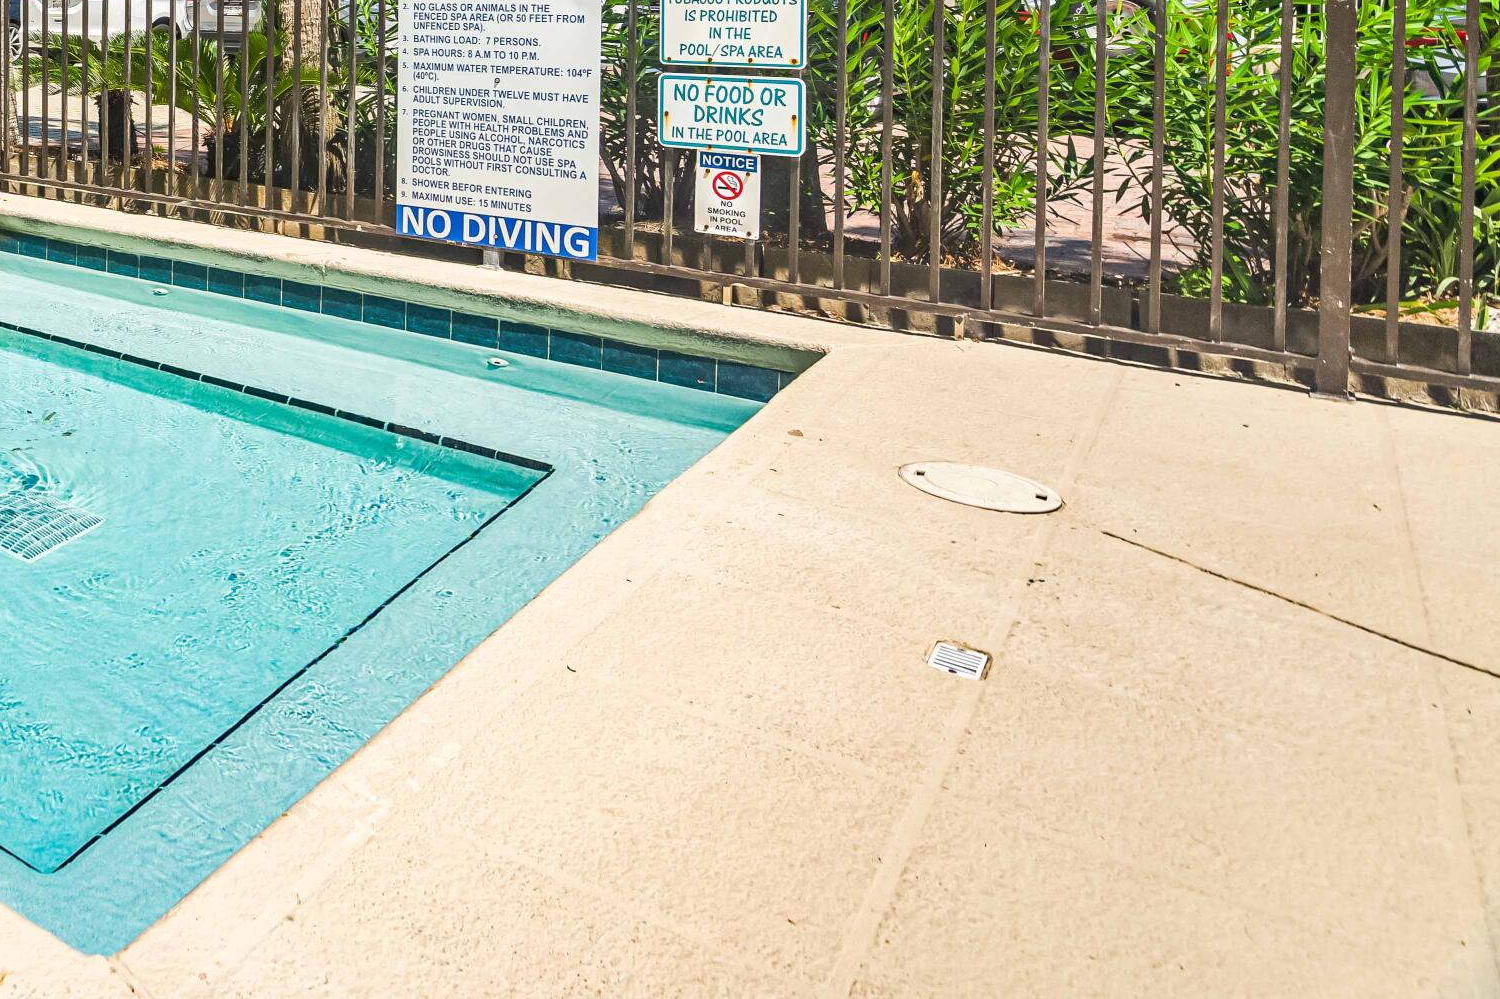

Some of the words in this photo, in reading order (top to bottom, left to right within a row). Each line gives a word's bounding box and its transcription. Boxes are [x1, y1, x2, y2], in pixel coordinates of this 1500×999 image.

[414, 3, 426, 11] NO
[428, 3, 457, 12] GLASS
[460, 3, 473, 12] OR
[475, 4, 516, 12] ANIMALS
[519, 4, 528, 12] IN
[531, 4, 550, 12] THE
[414, 12, 448, 20] FENCED
[450, 13, 467, 21] SPA
[469, 13, 494, 22] AREA
[497, 14, 513, 23] (OR
[516, 14, 526, 22] 50
[529, 14, 554, 22] FEET
[556, 15, 584, 23] FROM
[685, 9, 696, 21] IS
[700, 10, 777, 22] PROHIBITED
[414, 22, 460, 30] UNFENCED
[463, 23, 485, 32] SPA).
[709, 27, 721, 39] IN
[725, 27, 751, 40] THE
[414, 35, 450, 44] BATHING
[454, 36, 480, 44] LOAD:
[486, 37, 491, 45] 7
[494, 37, 540, 46] PERSONS.
[413, 48, 430, 56] SPA
[432, 49, 465, 58] HOURS:
[468, 50, 472, 58] 8
[493, 51, 506, 59] TO
[509, 51, 518, 60] 10
[522, 52, 539, 60] P.M.
[680, 43, 744, 57] POOL/SPA
[748, 45, 782, 58] AREA
[414, 62, 454, 71] MAXIMUM
[457, 64, 487, 73] WATER
[490, 65, 563, 76] TEMPERATURE:
[413, 71, 439, 82] (40°C).
[413, 85, 456, 95] CHILDREN
[459, 88, 490, 97] UNDER
[492, 90, 530, 100] TWELVE
[533, 92, 559, 101] MUST
[562, 94, 588, 103] HAVE
[674, 84, 699, 102] NO
[705, 85, 754, 104] FOOD
[760, 87, 786, 107] OR
[413, 95, 440, 104] ADULT
[443, 96, 505, 108] SUPERVISION.
[413, 109, 460, 120] PREGNANT
[502, 115, 534, 125] SMALL
[536, 117, 588, 130] CHILDREN,
[694, 104, 764, 126] DRINKS
[413, 118, 446, 128] PEOPLE
[449, 121, 470, 130] WITH
[474, 123, 509, 133] HEALTH
[512, 125, 564, 137] PROBLEMS
[567, 130, 588, 139] AND
[413, 128, 446, 138] PEOPLE
[449, 130, 476, 140] USING
[478, 133, 525, 145] ALCOHOL,
[528, 136, 585, 149] NARCOTICS
[672, 126, 684, 138] IN
[688, 127, 712, 140] THE
[716, 129, 750, 143] POOL
[753, 132, 787, 146] AREA
[412, 137, 425, 145] OR
[427, 138, 456, 148] OTHER
[459, 141, 490, 151] DRUGS
[493, 144, 517, 153] THAT
[520, 146, 552, 156] CAUSE
[413, 146, 470, 159] DROWSINESS
[473, 152, 510, 162] SHOULD
[513, 155, 532, 165] NOT
[535, 157, 554, 167] USE
[557, 159, 576, 169] SPA
[703, 155, 754, 169] NOTICE
[412, 156, 441, 166] POOLS
[444, 159, 484, 170] WITHOUT
[487, 162, 513, 173] FIRST
[515, 165, 577, 179] CONSULTING
[580, 172, 587, 180] A
[412, 165, 450, 176] DOCTOR.
[412, 178, 450, 190] SHOWER
[452, 182, 482, 193] BEFOR
[485, 186, 532, 198] ENTERING
[412, 191, 452, 203] MAXIMUM
[455, 196, 475, 206] USE:
[479, 199, 488, 207] 15
[491, 200, 532, 212] MINUTES
[708, 207, 745, 217] SMOKING
[720, 217, 743, 226] POOL
[402, 207, 451, 238] NO
[463, 214, 589, 257] DIVING
